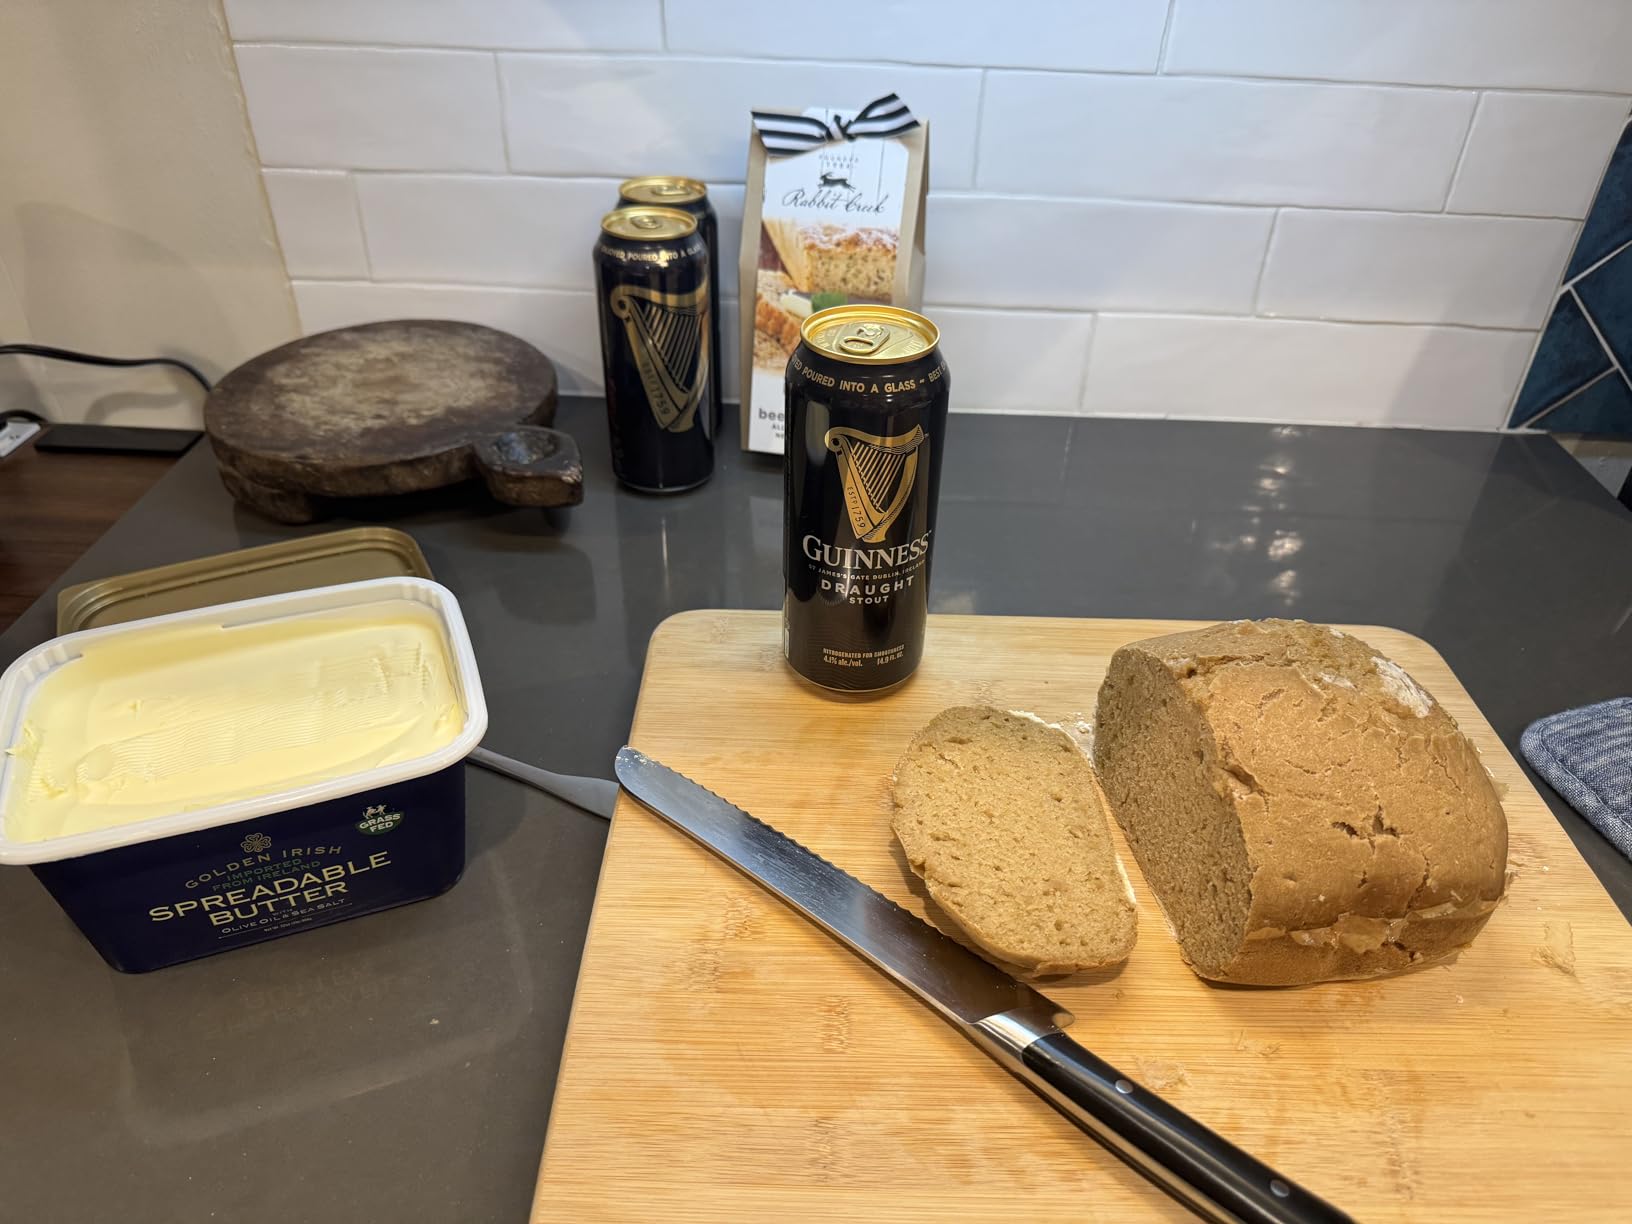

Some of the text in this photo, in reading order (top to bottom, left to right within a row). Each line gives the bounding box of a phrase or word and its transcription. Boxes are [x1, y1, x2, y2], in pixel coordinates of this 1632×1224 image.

[782, 189, 889, 216] Rabbit Creek
[659, 250, 679, 262] NTO
[680, 248, 687, 258] A
[802, 366, 835, 387] POURED
[839, 380, 865, 393] INTO
[870, 386, 879, 394] A
[884, 379, 916, 393] GLASS
[802, 533, 929, 570] GUINNESS
[821, 575, 914, 596] DRAUGHT
[850, 573, 870, 581] GATE
[849, 595, 889, 605] STOUT
[360, 813, 401, 829] GRASS
[370, 821, 394, 832] FED
[185, 845, 342, 889] GOLDEN IRISH
[212, 860, 321, 892] FROM IRELAND
[227, 858, 302, 881] IMPORTED
[148, 850, 392, 922] SPREADABLE
[208, 881, 349, 926] BUTTER
[221, 921, 258, 934] OLIVE
[259, 914, 281, 925] OIL
[291, 907, 315, 917] SEA
[316, 898, 346, 910] SALT
